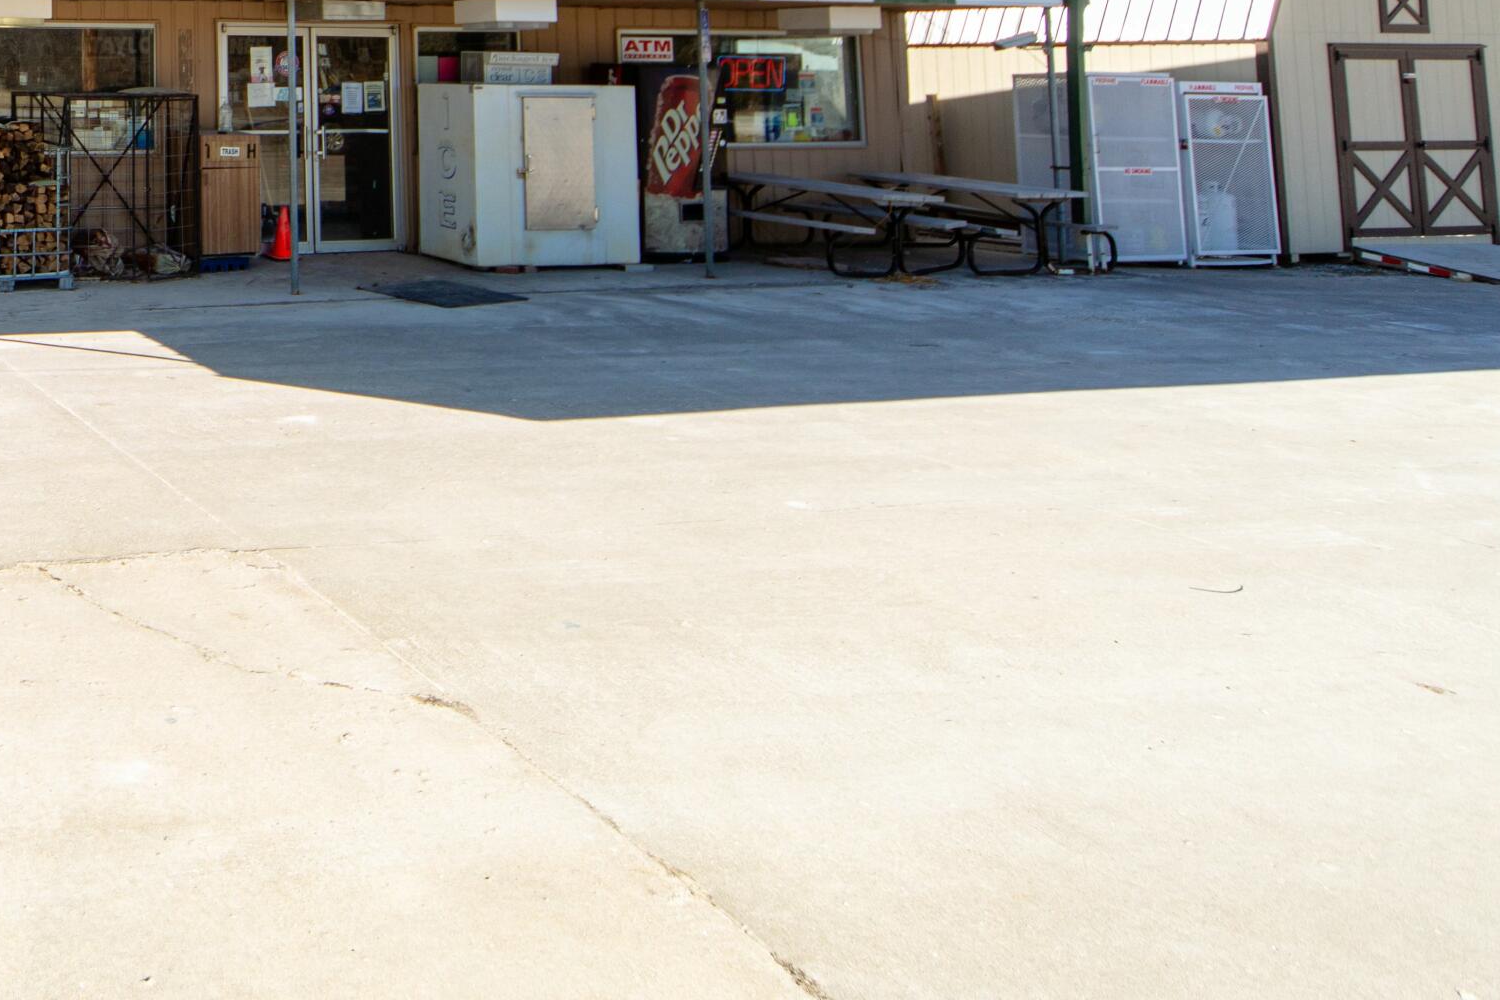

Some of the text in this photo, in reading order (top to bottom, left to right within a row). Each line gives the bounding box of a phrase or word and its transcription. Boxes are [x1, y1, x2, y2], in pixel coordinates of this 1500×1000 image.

[624, 39, 671, 52] ATM
[720, 57, 785, 89] OPEN
[662, 100, 688, 142] Dr
[653, 103, 701, 184] Pepp
